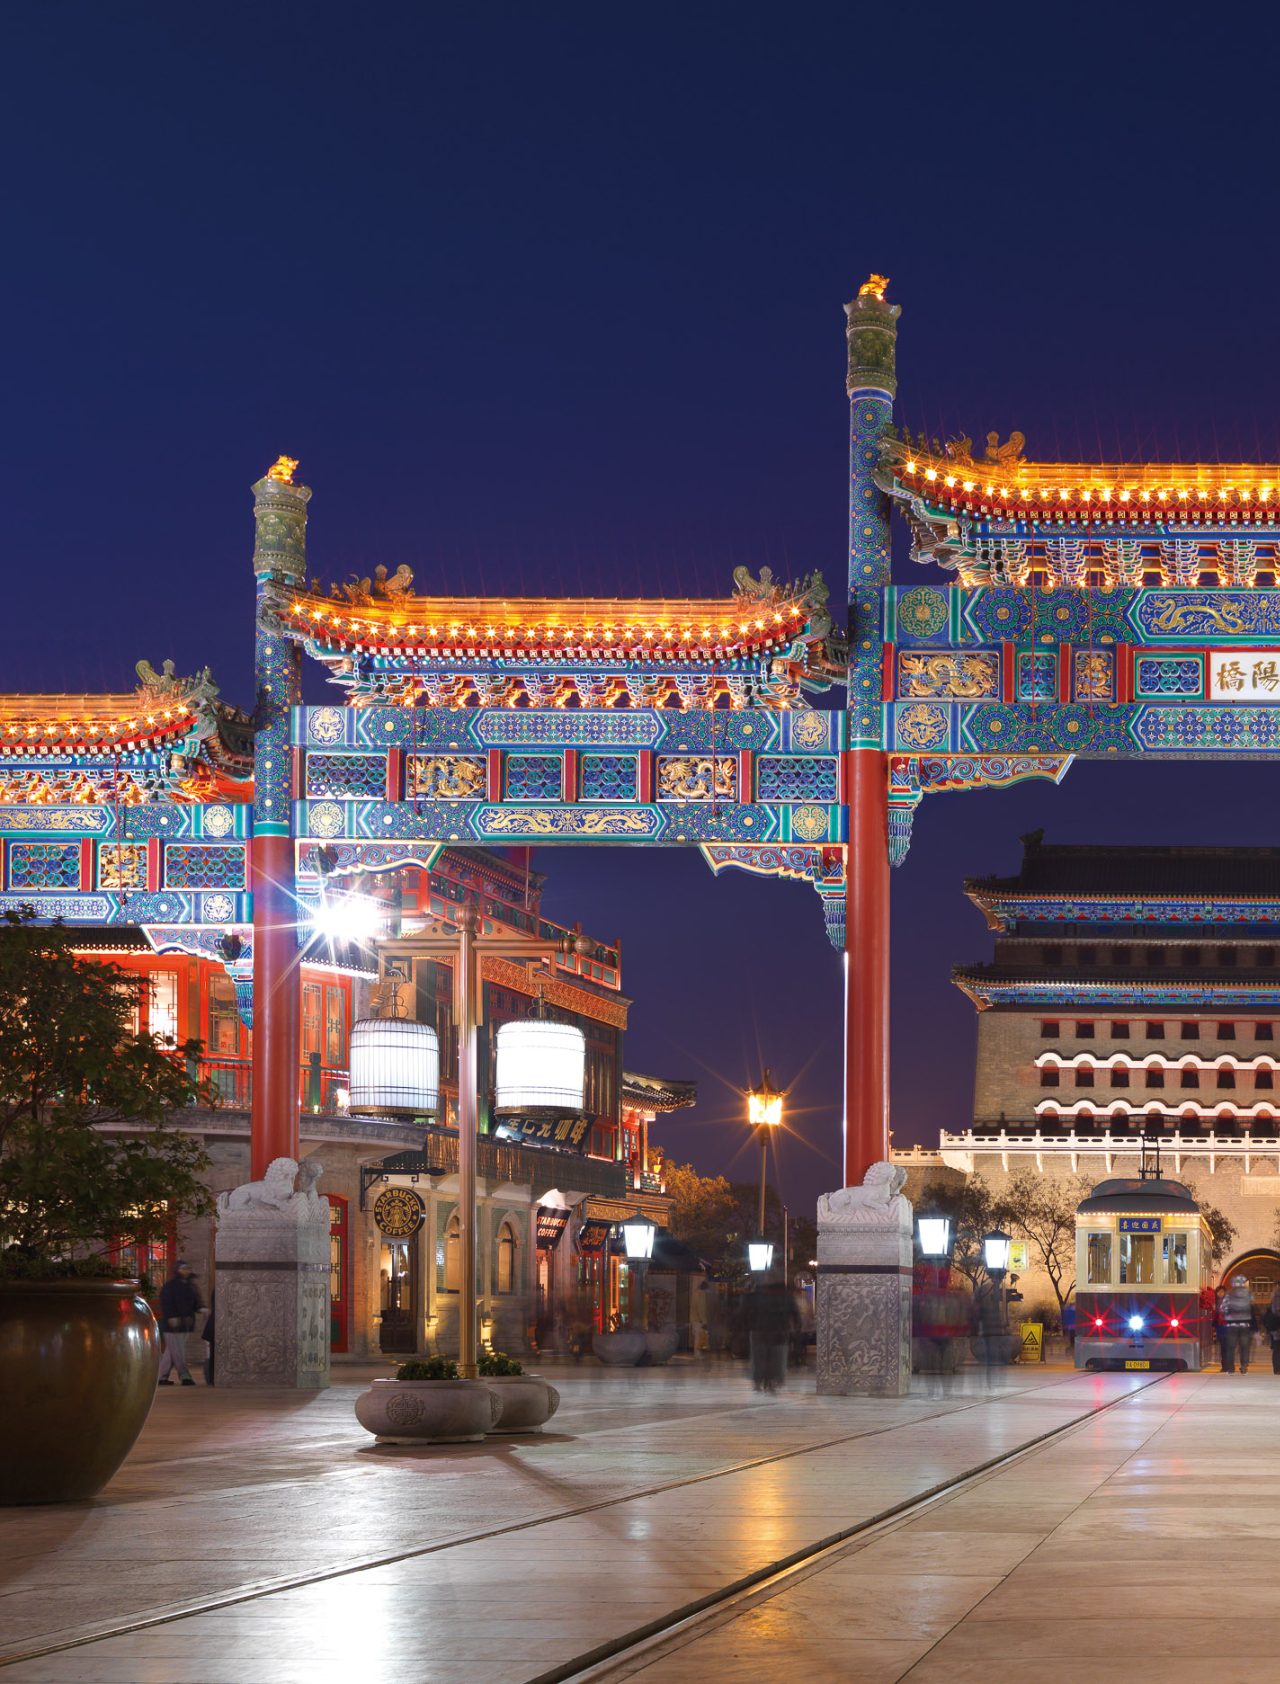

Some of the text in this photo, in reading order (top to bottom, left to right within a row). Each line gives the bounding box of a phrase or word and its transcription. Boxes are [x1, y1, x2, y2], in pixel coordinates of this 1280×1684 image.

[375, 1189, 419, 1212] STARBUCKS
[379, 1221, 415, 1236] COFFEE
[537, 1227, 558, 1238] COFFEE
